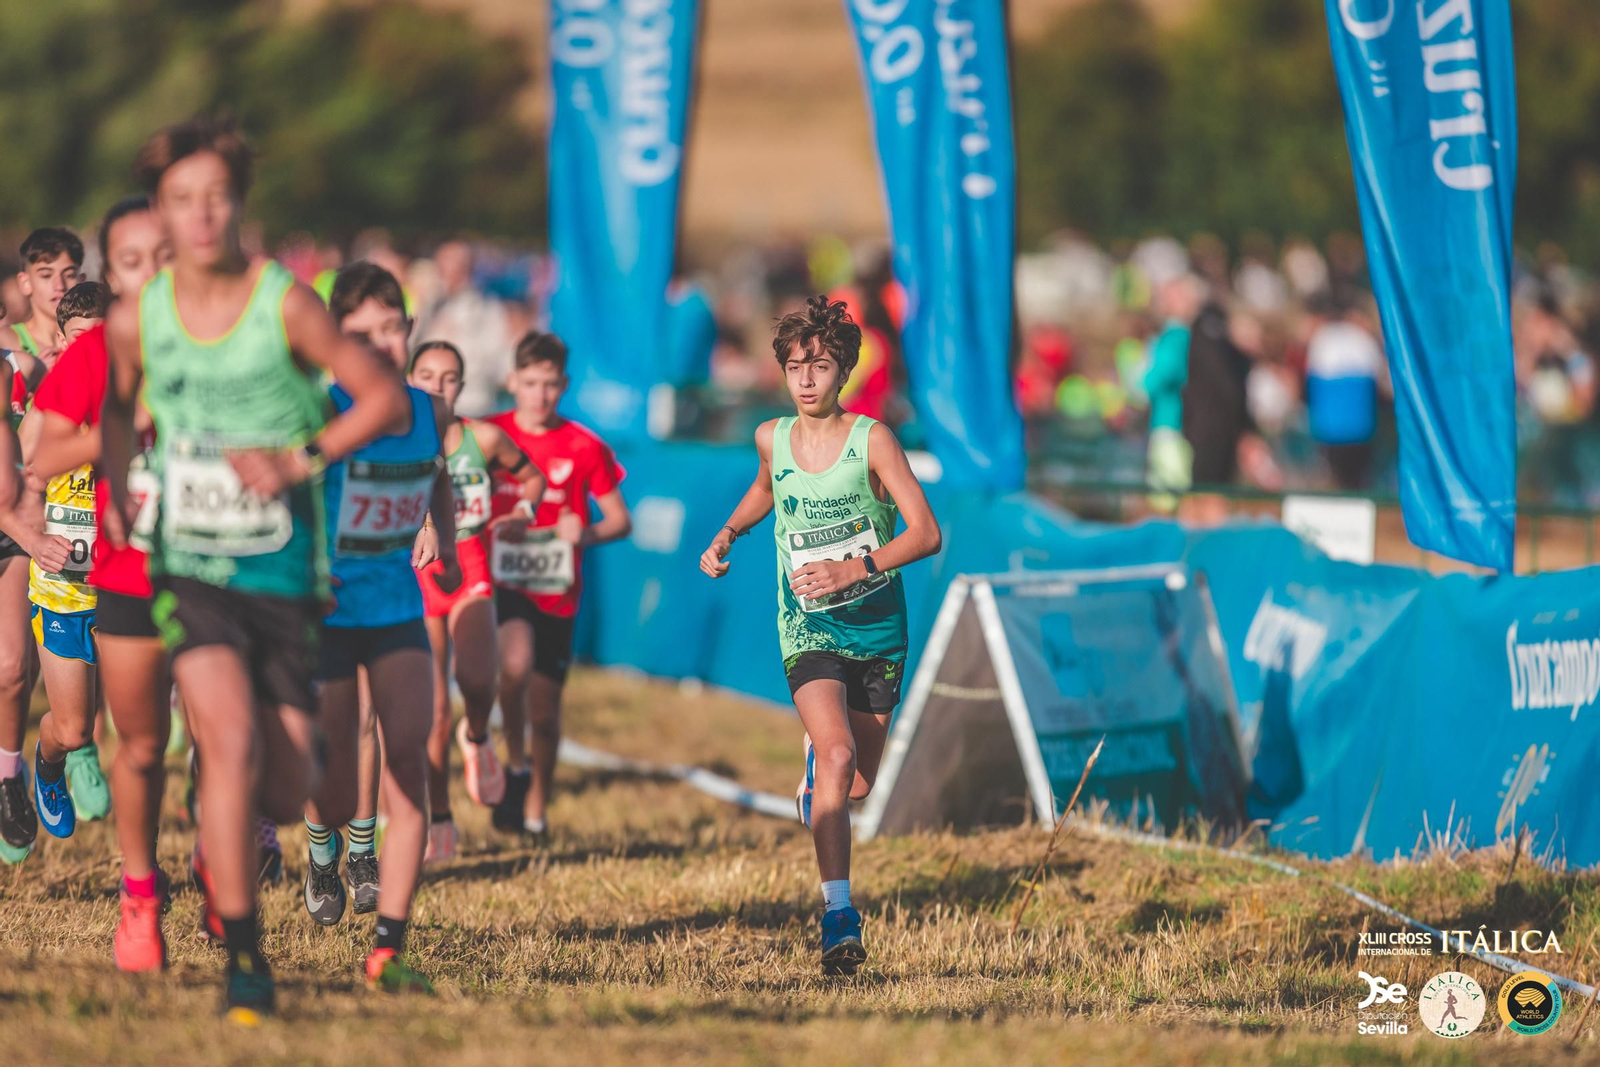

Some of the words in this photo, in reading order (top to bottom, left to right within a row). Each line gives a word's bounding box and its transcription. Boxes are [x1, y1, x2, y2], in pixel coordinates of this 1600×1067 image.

[802, 492, 861, 509] Fundación
[804, 507, 852, 519] Unicaja
[808, 525, 851, 544] ITÁLICA
